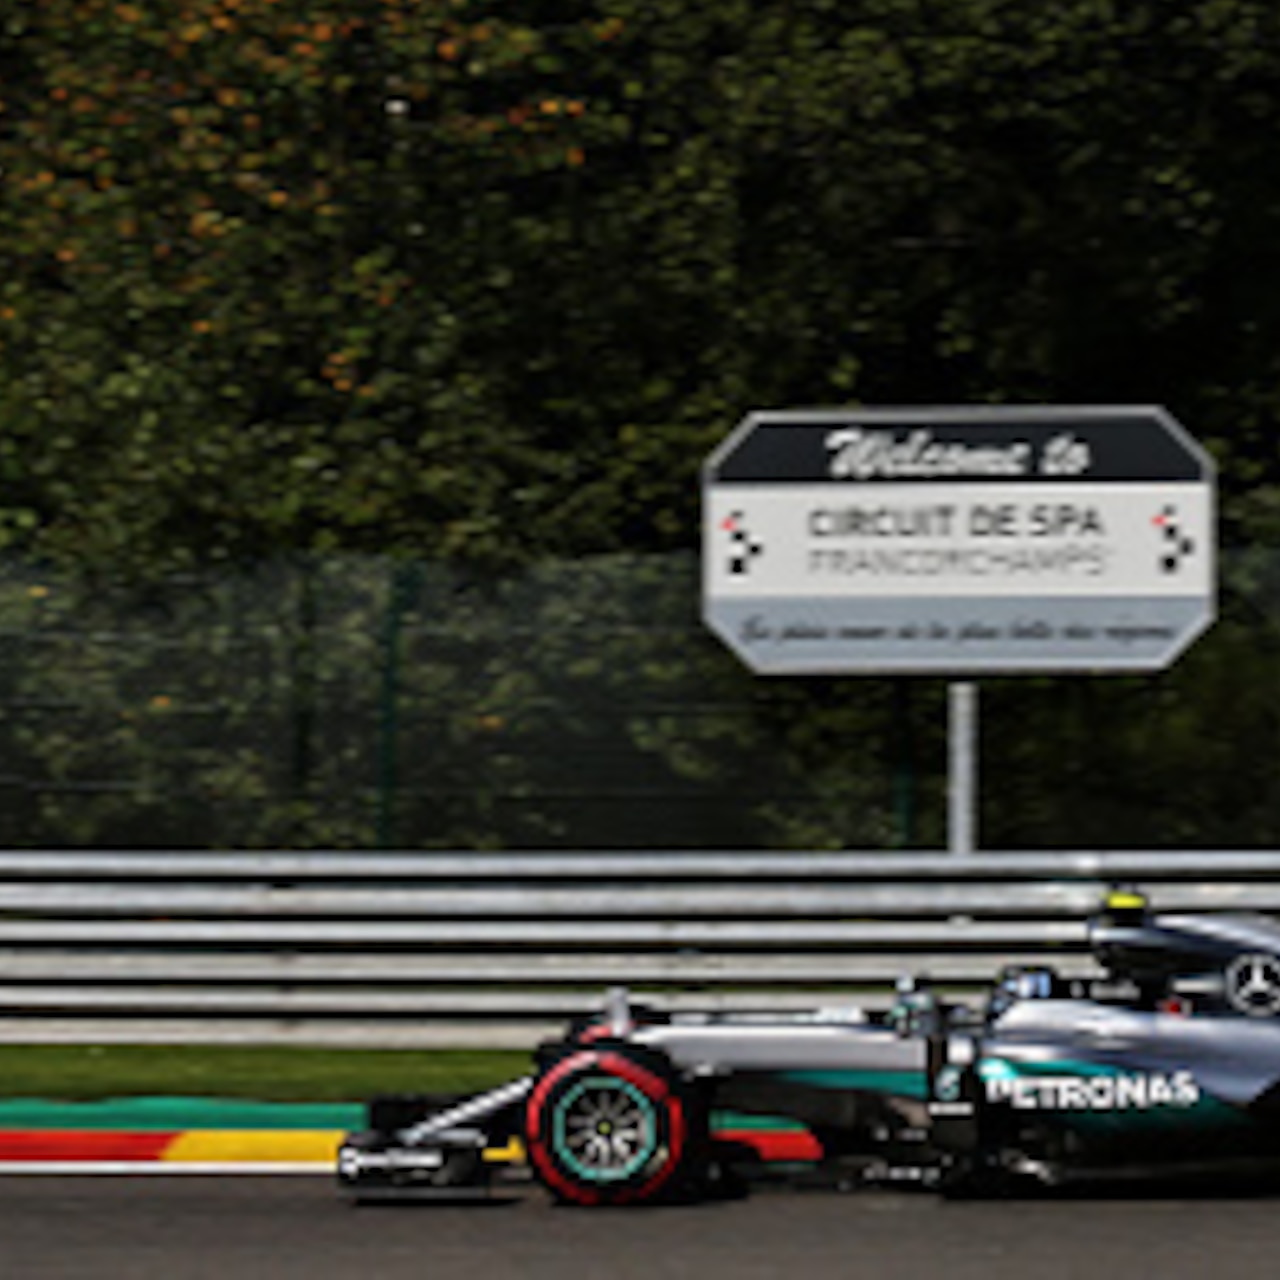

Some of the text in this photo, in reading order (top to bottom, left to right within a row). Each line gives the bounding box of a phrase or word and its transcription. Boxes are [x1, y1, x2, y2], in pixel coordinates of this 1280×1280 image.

[824, 426, 1090, 479] Welcome to
[809, 503, 1106, 537] CIRCUIT DE SPA
[985, 1070, 1200, 1110] PETRONAS
